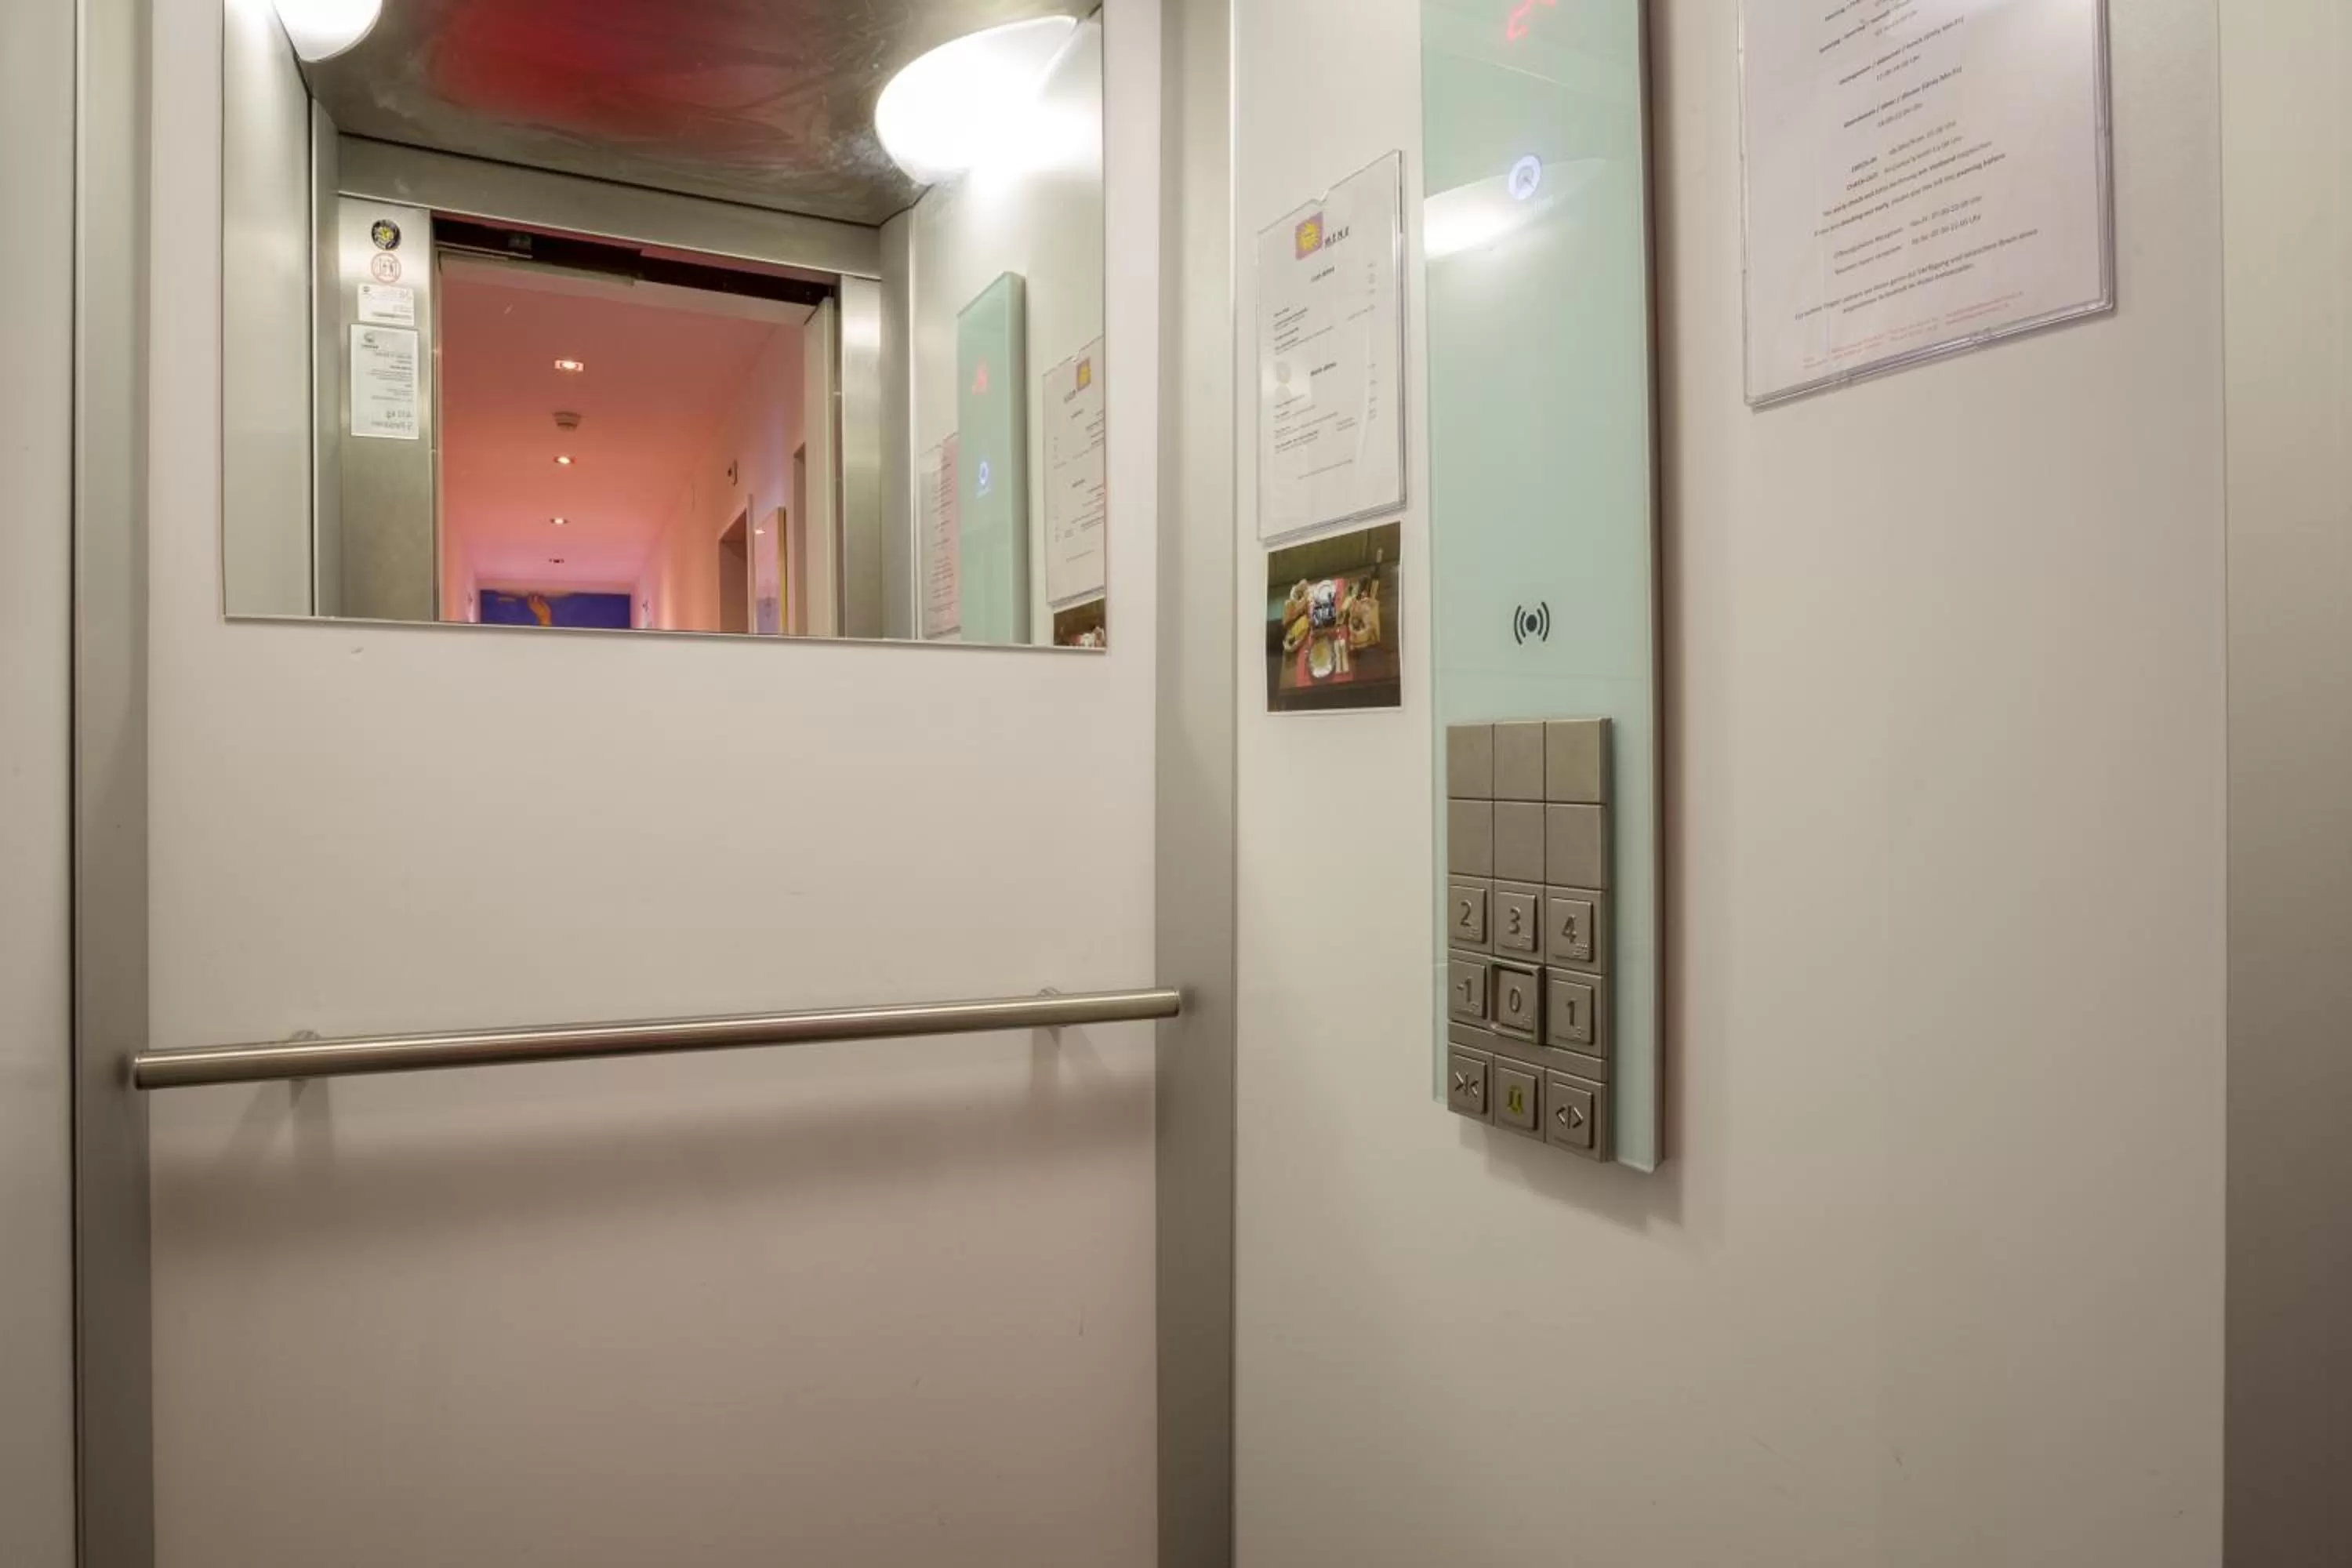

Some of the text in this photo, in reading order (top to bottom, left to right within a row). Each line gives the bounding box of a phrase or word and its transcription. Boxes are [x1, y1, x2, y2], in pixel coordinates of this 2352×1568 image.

[1460, 899, 1472, 927] 2
[1508, 906, 1521, 935] 3
[1561, 914, 1577, 943] 4
[1456, 977, 1472, 1004] -1
[1509, 985, 1521, 1014] 0
[1566, 998, 1576, 1026] 1
